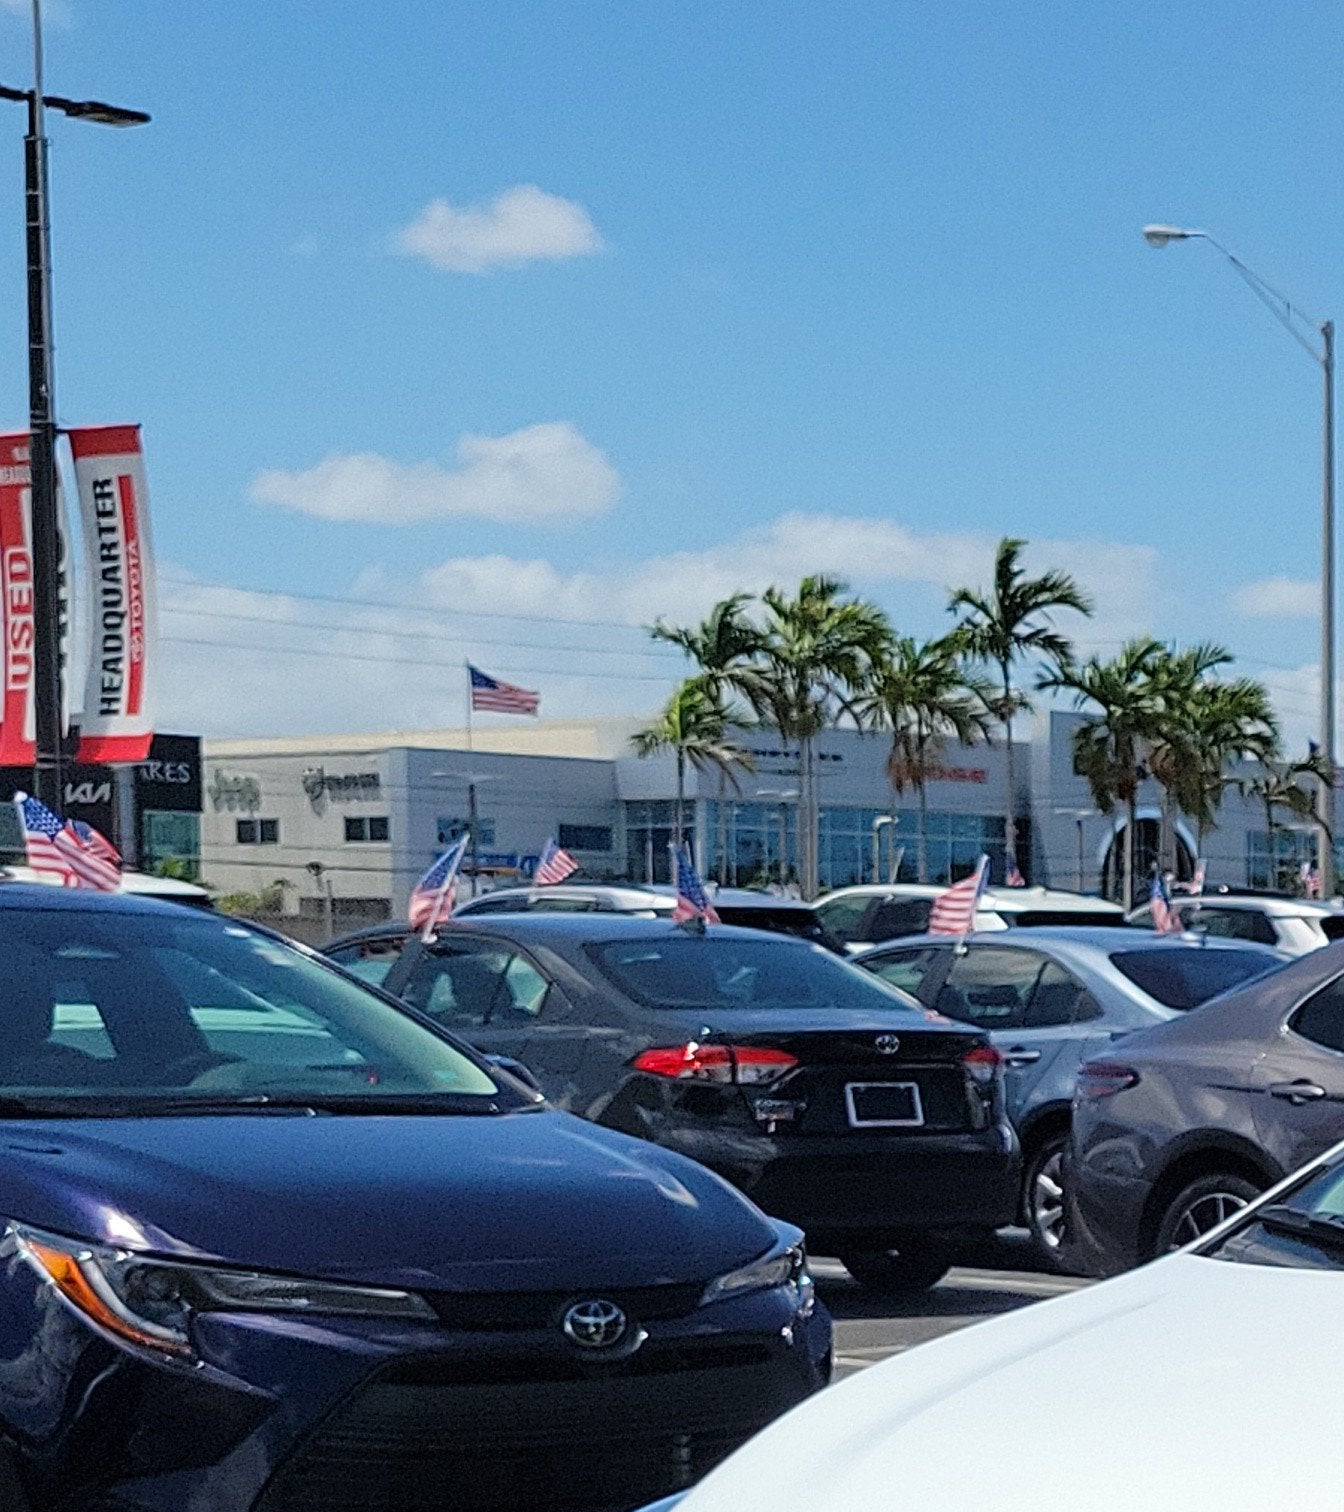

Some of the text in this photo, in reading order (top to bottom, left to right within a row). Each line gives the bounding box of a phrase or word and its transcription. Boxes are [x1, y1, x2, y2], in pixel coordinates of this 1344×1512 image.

[8, 552, 34, 685] USED
[92, 478, 127, 716] HEADQUARTER
[127, 540, 143, 631] TOYOTA
